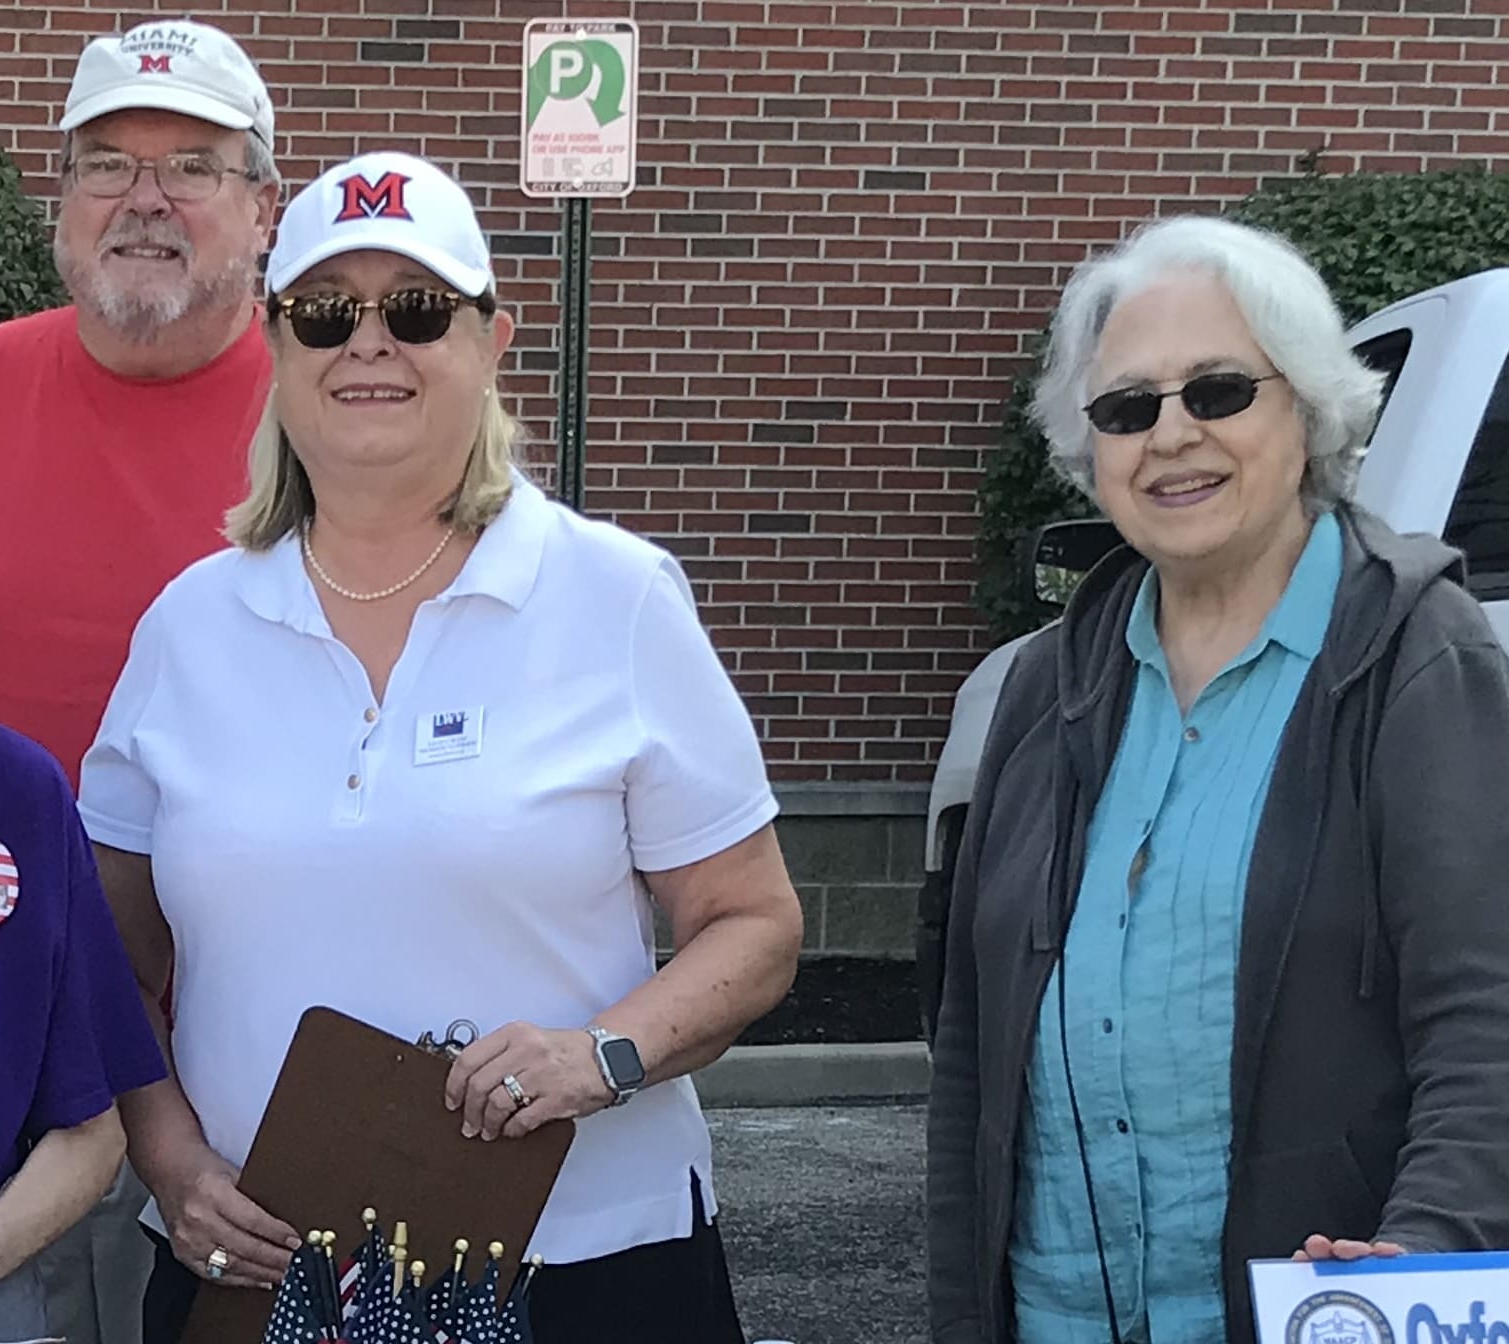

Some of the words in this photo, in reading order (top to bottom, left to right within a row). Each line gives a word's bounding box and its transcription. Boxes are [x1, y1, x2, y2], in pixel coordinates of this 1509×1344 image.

[120, 28, 197, 47] MIAMI
[121, 42, 194, 56] UNIVERSITY
[137, 54, 173, 73] M
[550, 49, 583, 94] P
[333, 170, 414, 223] M
